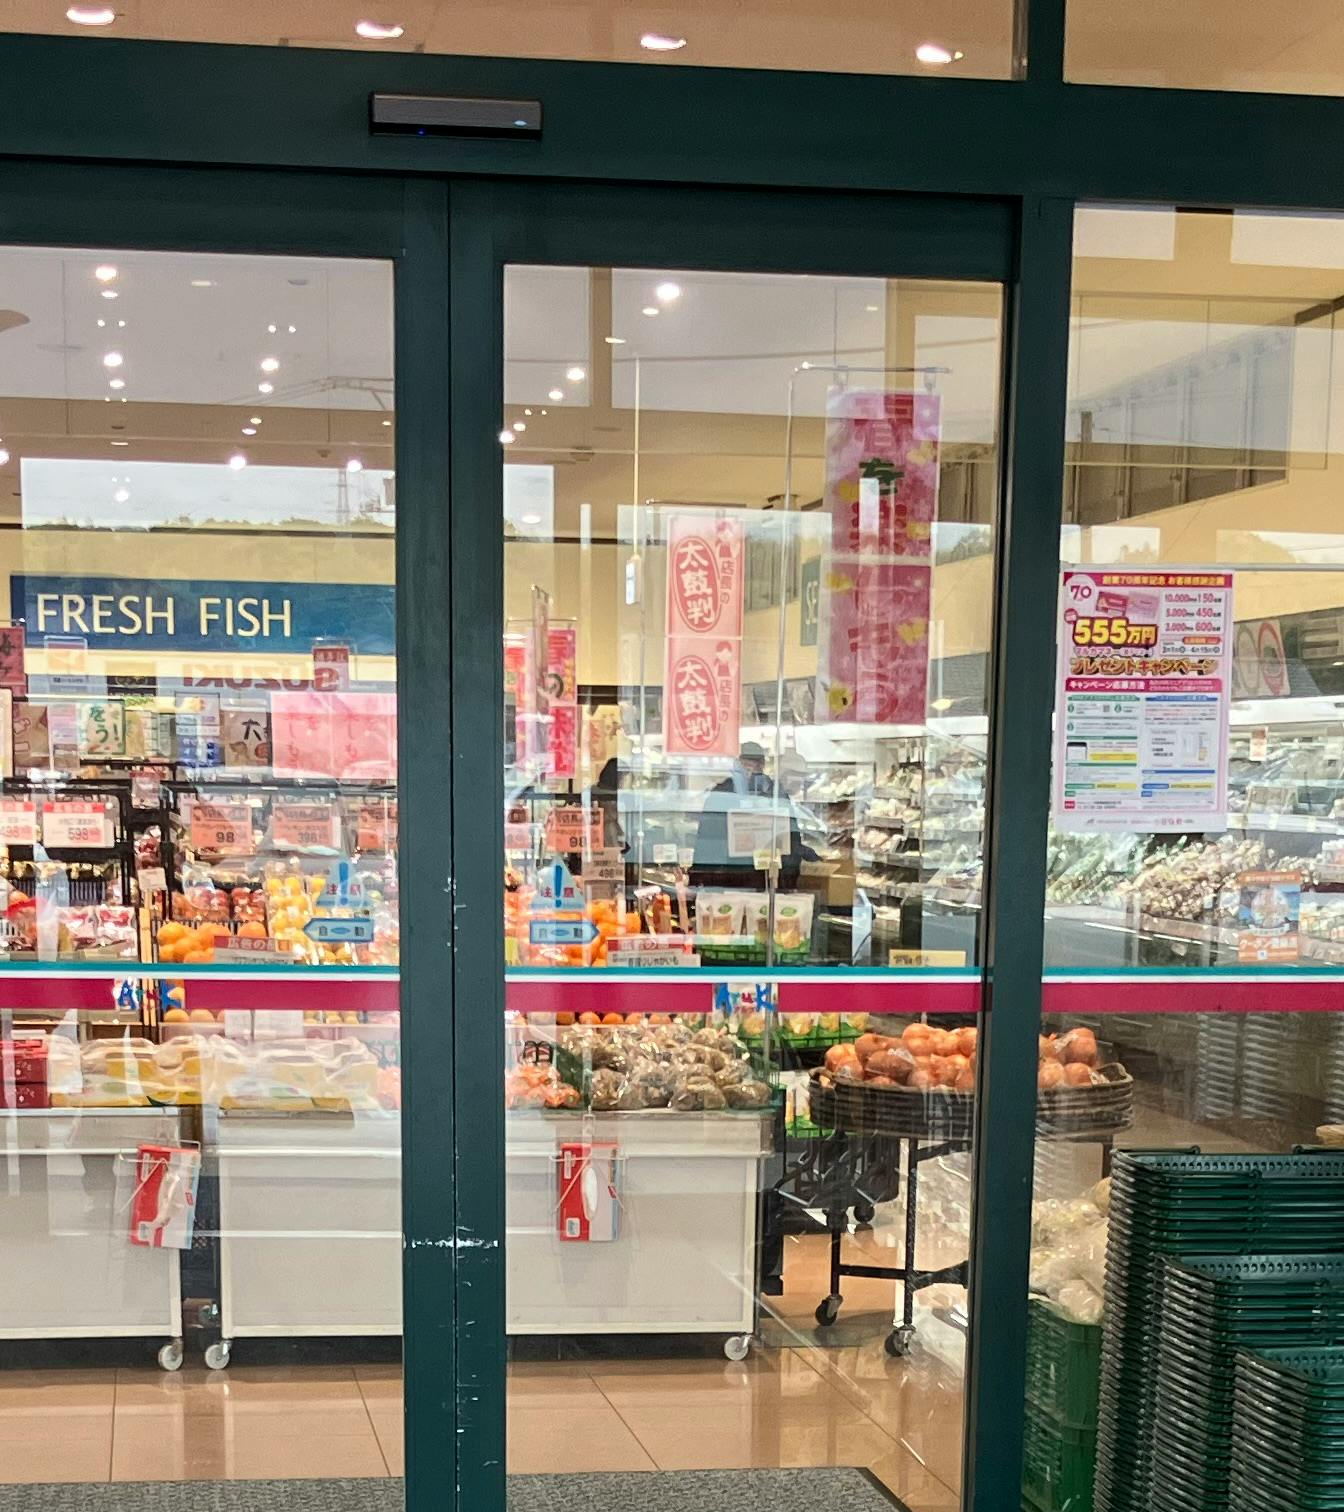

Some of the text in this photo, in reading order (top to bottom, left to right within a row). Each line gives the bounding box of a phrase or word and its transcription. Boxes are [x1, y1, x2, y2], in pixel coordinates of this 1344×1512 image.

[36, 593, 292, 637] FRESH FISH
[679, 541, 716, 626] 太鼓判
[1073, 616, 1158, 646] 555万円
[677, 660, 715, 744] 太鼓判
